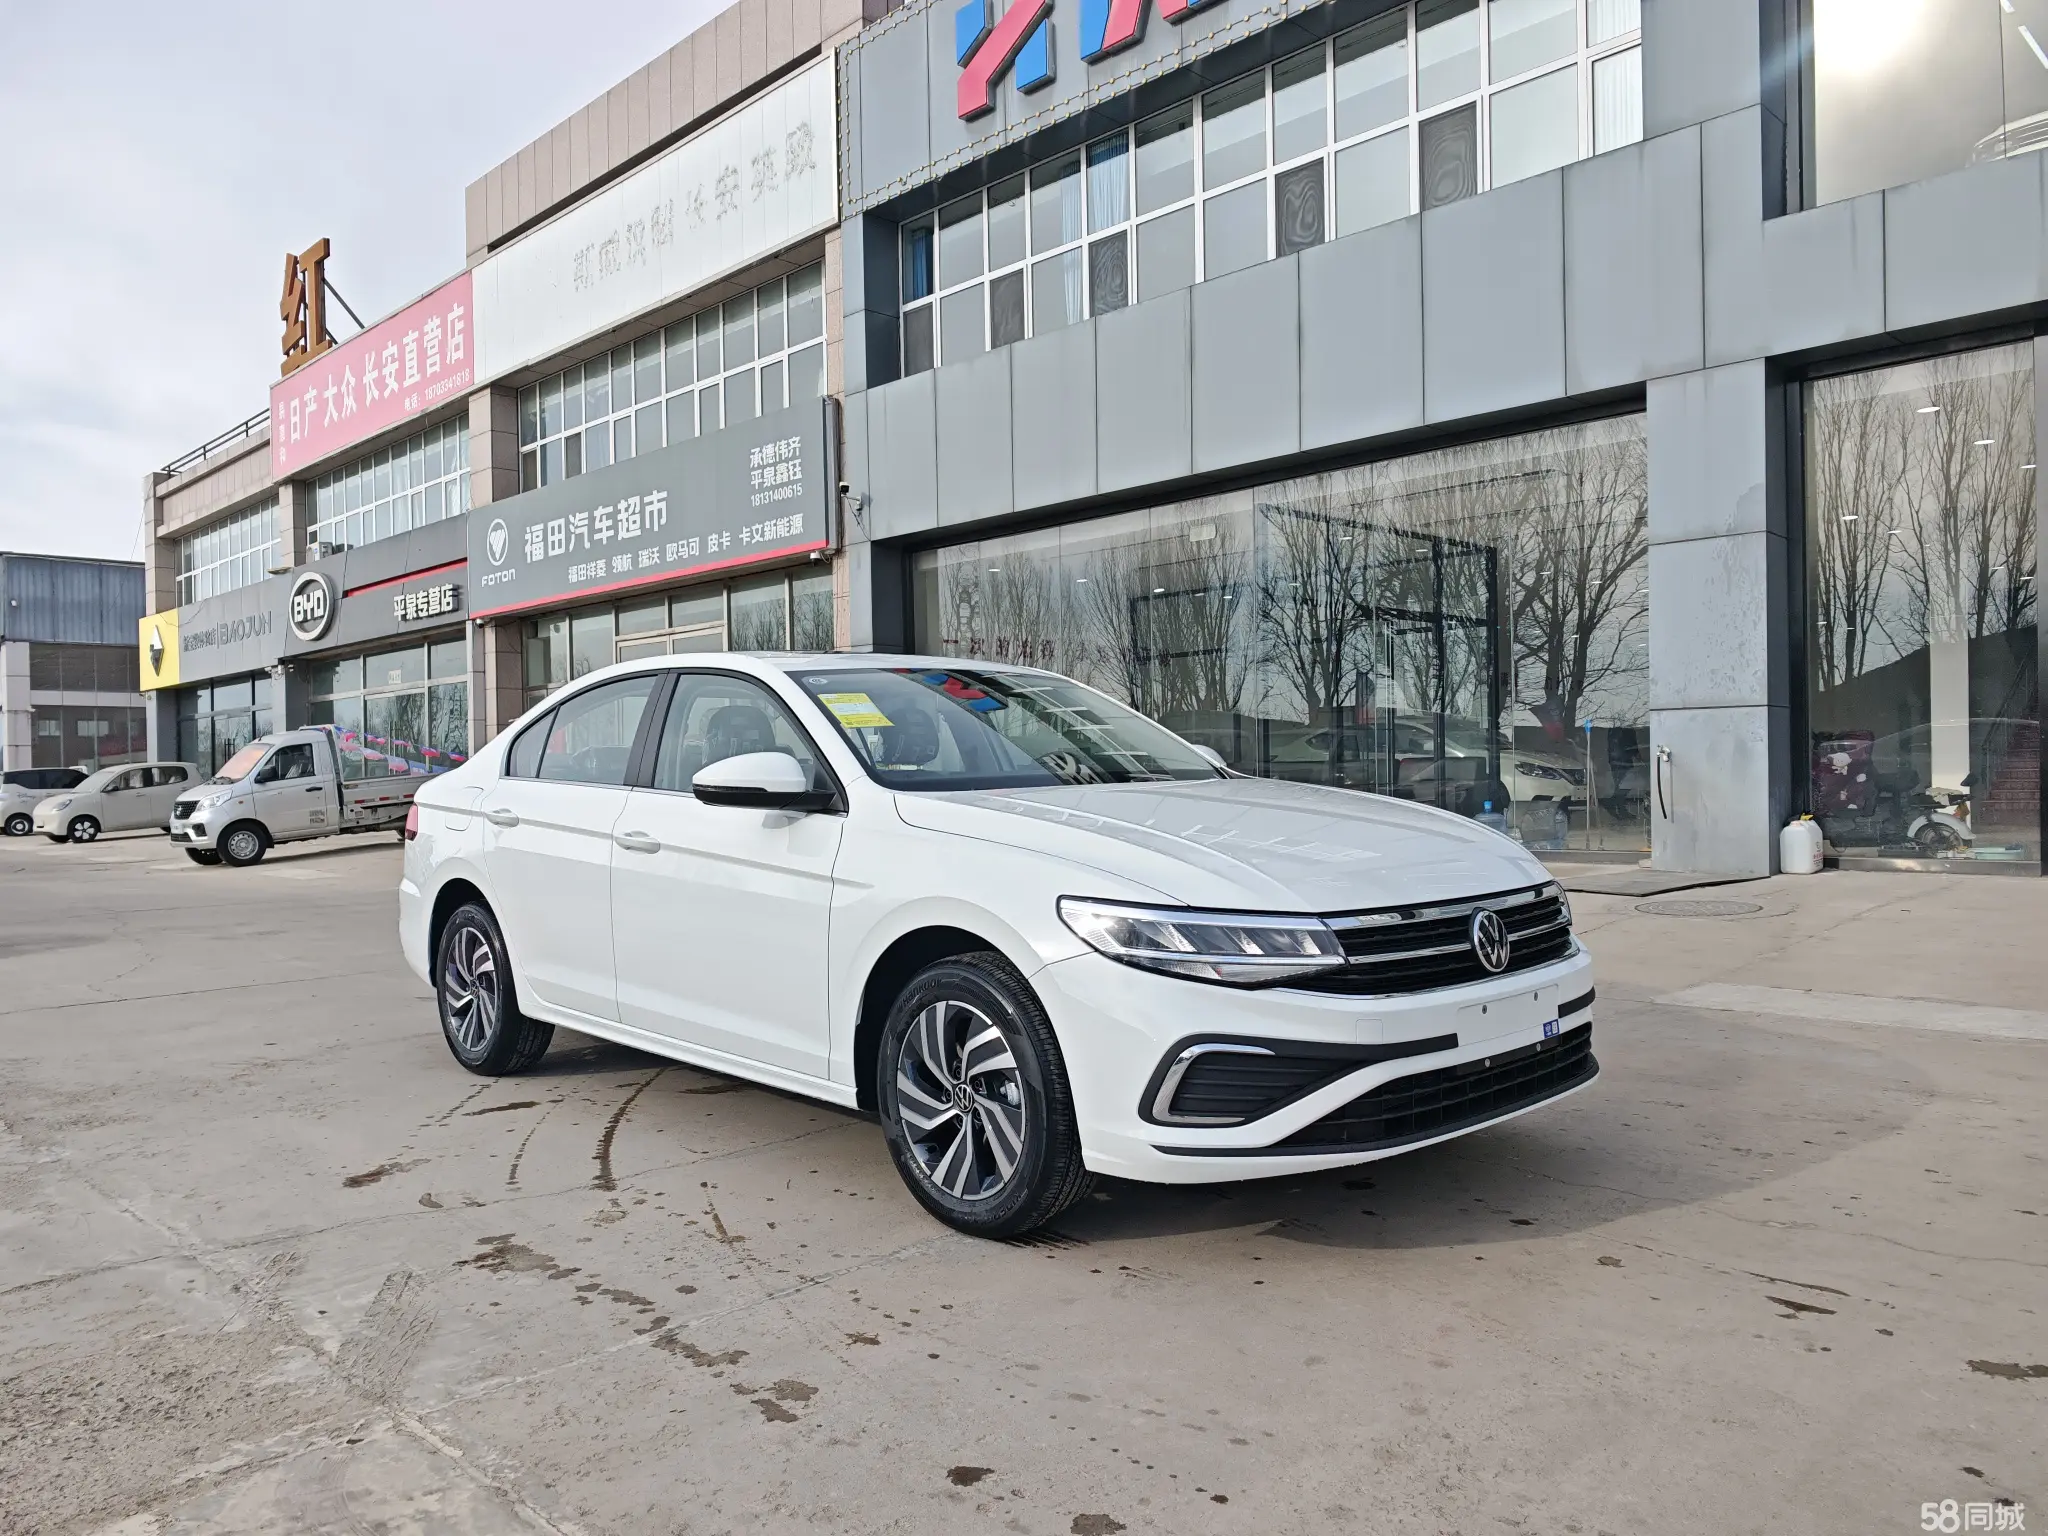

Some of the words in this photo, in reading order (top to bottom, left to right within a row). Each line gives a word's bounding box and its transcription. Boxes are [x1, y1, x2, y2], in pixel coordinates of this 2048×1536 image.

[280, 238, 333, 376] 红
[425, 368, 470, 401] 18703341818
[750, 436, 801, 468] 承德伟齐
[750, 459, 802, 489] 平泉鑫钰
[751, 482, 803, 507] 18131400615
[525, 490, 668, 563] 福田汽车超市
[568, 559, 607, 584] 福田祥菱
[612, 553, 633, 573] 领航
[638, 546, 661, 568] 瑞沃
[666, 537, 700, 562] 欧马可
[707, 530, 731, 553] 皮卡
[739, 513, 804, 546] 卡文新能源
[481, 568, 516, 587] FOTON
[293, 588, 325, 623] BYD
[393, 583, 455, 621] 平泉专营店
